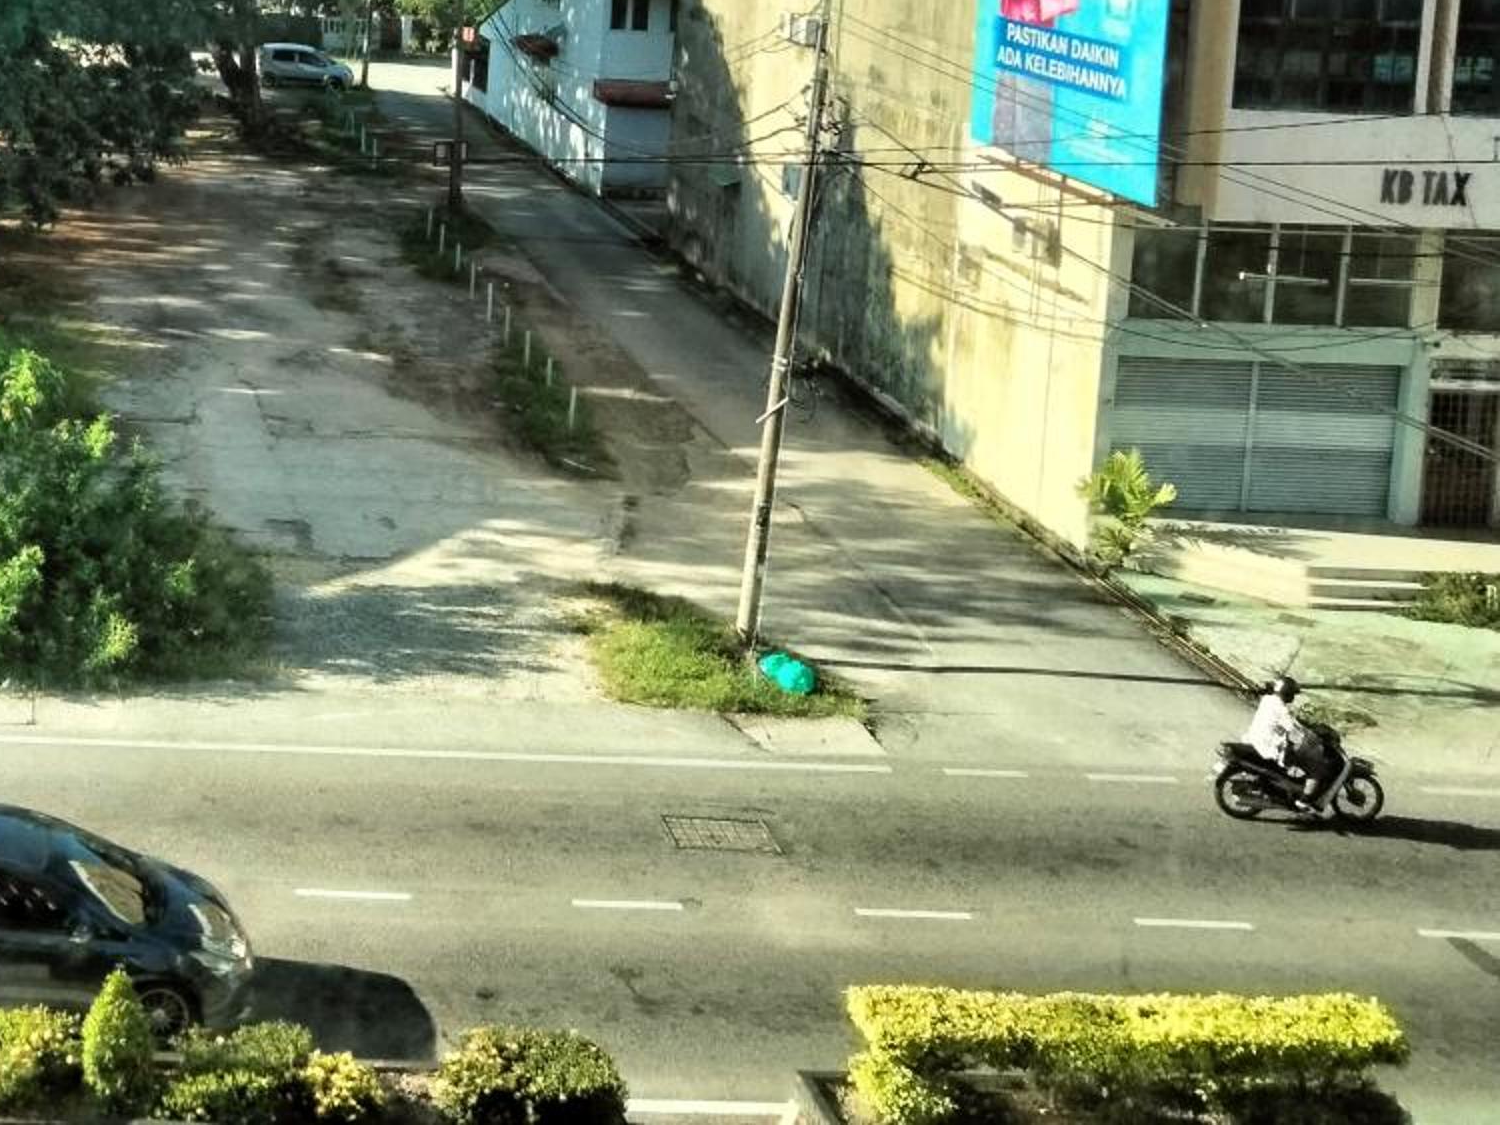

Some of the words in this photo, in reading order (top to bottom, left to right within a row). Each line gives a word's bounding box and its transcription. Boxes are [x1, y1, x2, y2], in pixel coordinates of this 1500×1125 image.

[1006, 22, 1069, 56] PASTIKAN
[1070, 38, 1120, 69] DAIKIN
[997, 45, 1023, 69] ADA
[1024, 53, 1127, 98] KELEBIHANNYA
[1380, 167, 1414, 205] KB
[1422, 169, 1473, 207] TAX
